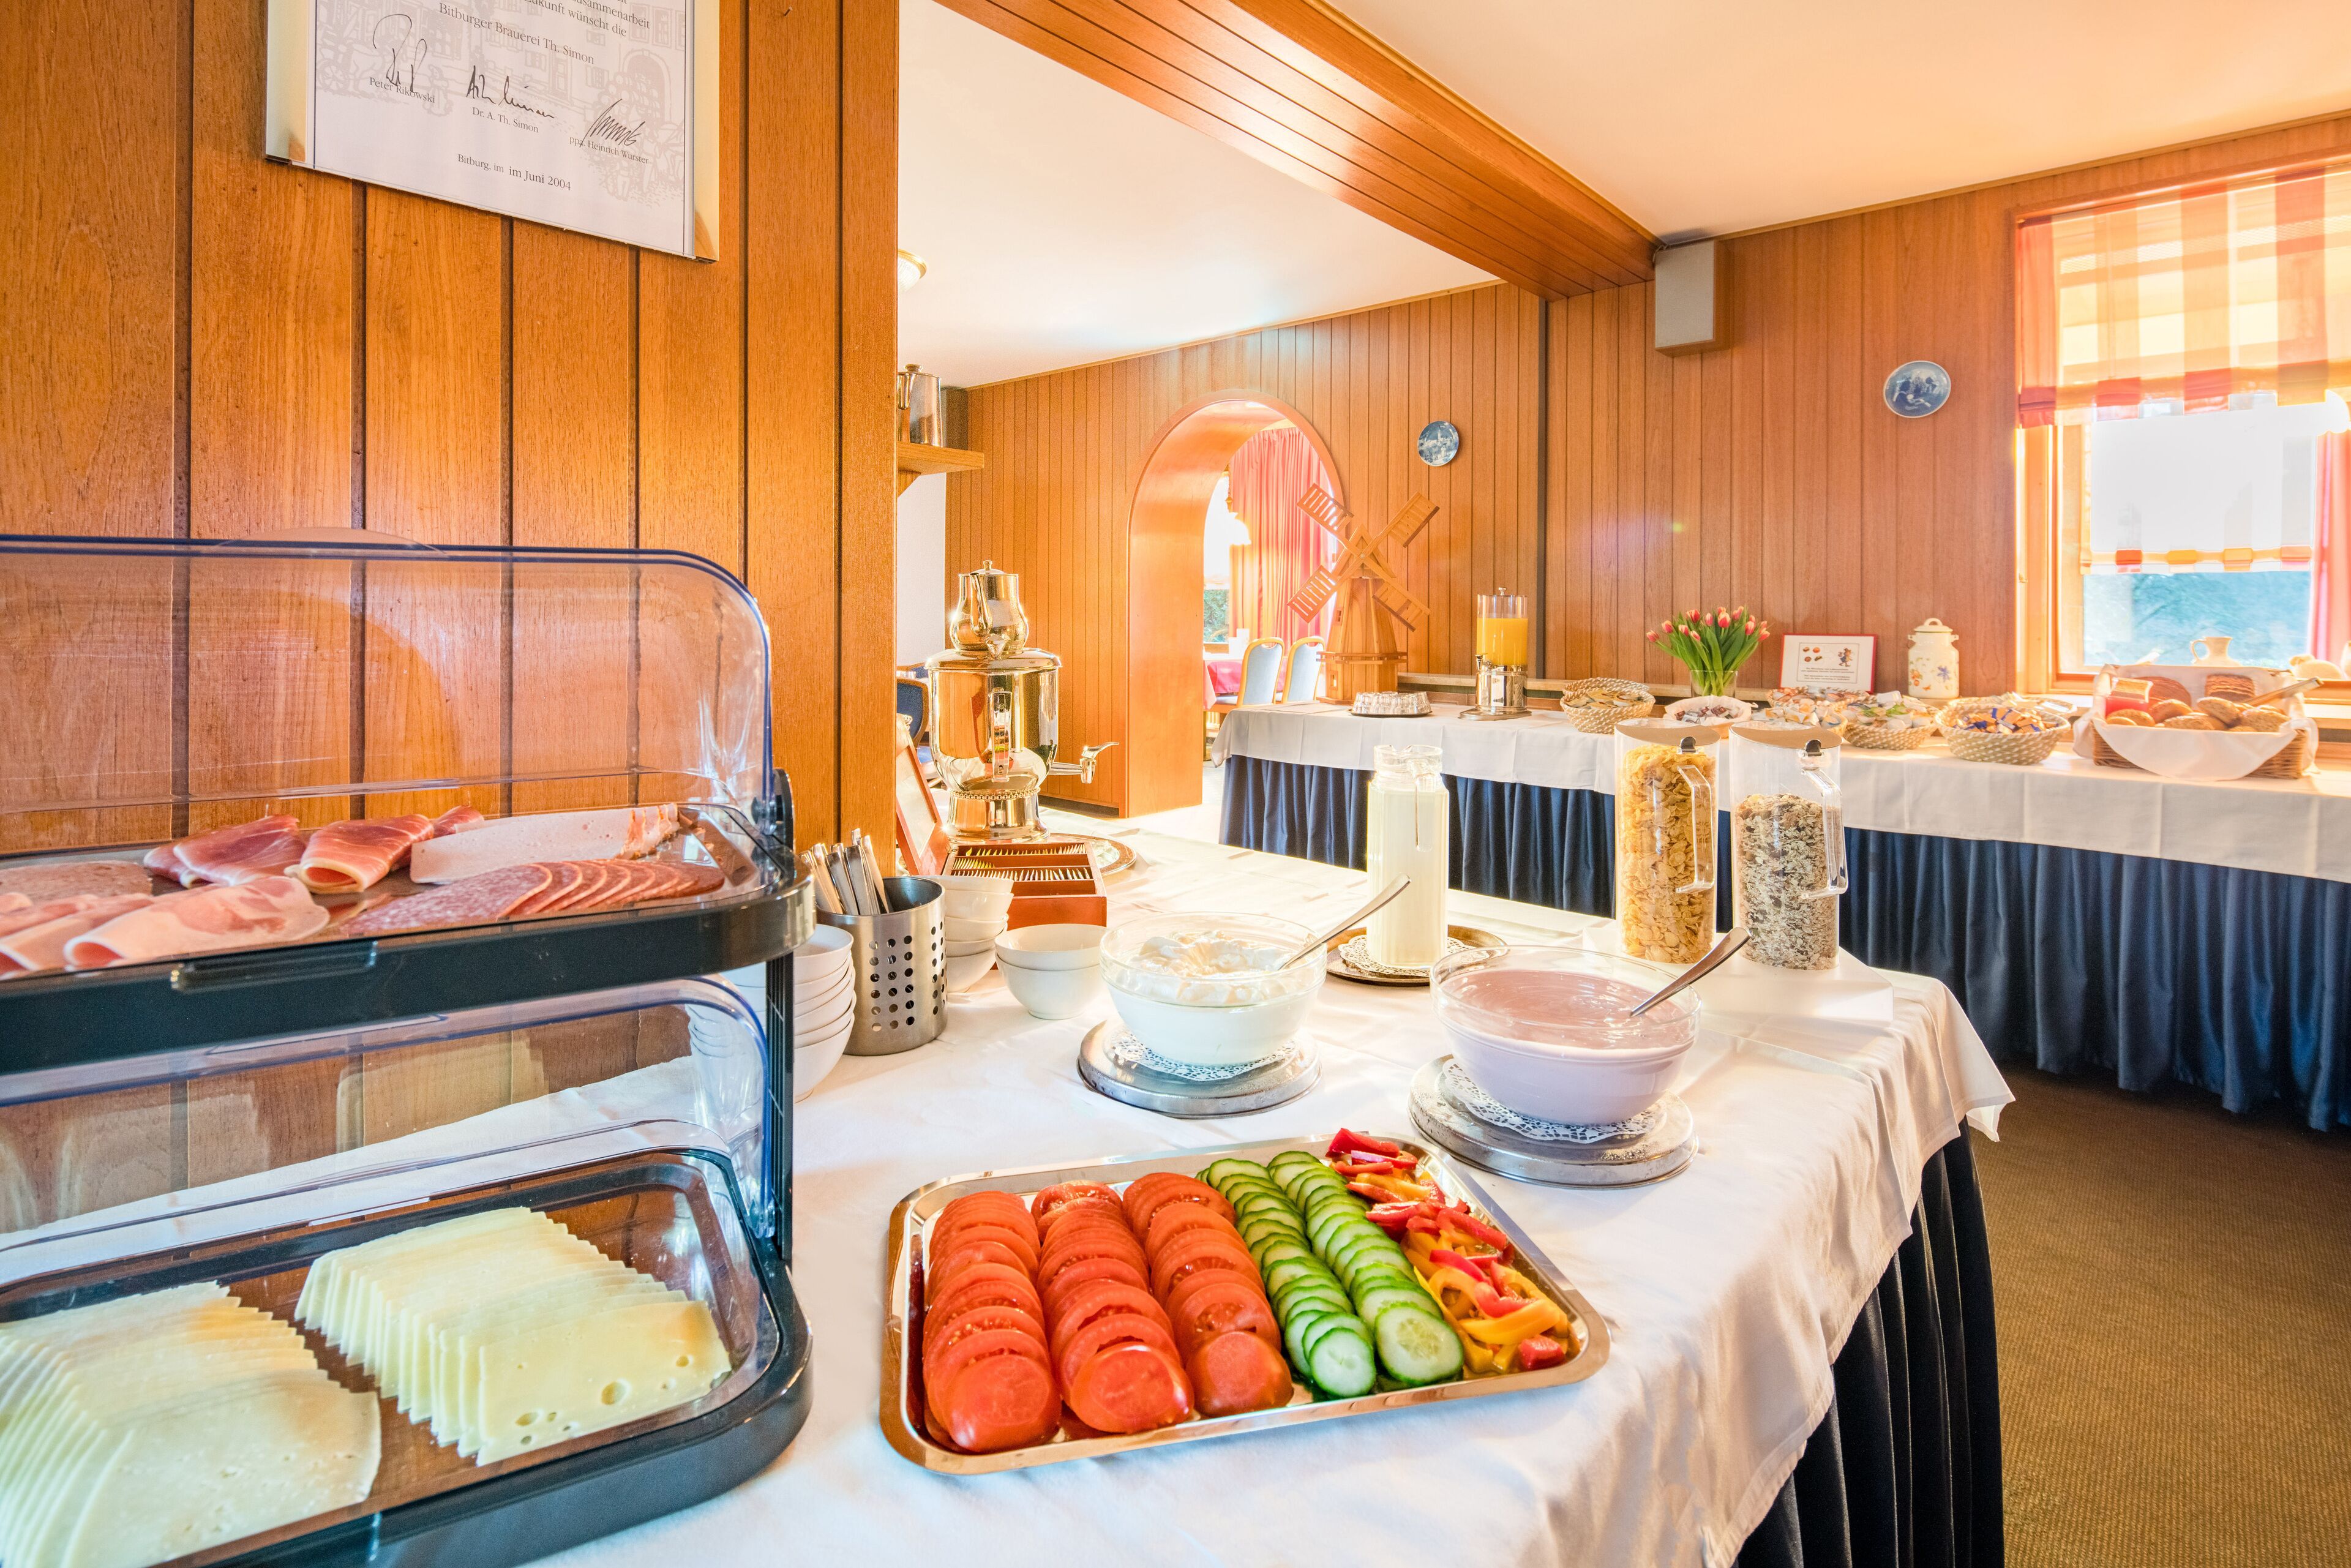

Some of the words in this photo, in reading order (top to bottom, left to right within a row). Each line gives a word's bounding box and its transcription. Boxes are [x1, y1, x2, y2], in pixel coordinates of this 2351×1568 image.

[568, 8, 609, 31] wünscht
[612, 24, 627, 37] die
[572, 0, 650, 29] usammenarbeit
[439, 2, 492, 29] Bitburger
[495, 21, 540, 46] Brauerei
[543, 37, 560, 53] Th.
[563, 45, 594, 64] Simon
[369, 77, 393, 91] Peter
[397, 84, 435, 103] Rikowski
[472, 107, 485, 118] Dr.
[487, 111, 495, 121] A.
[498, 114, 511, 126] Th.
[513, 117, 539, 133] Simon
[588, 140, 619, 156] Heinrich
[621, 149, 649, 164] Wurster
[457, 153, 491, 171] Bitburg,
[493, 162, 504, 173] im
[509, 166, 522, 178] im
[524, 170, 545, 184] Juni
[548, 176, 571, 191] 2004
